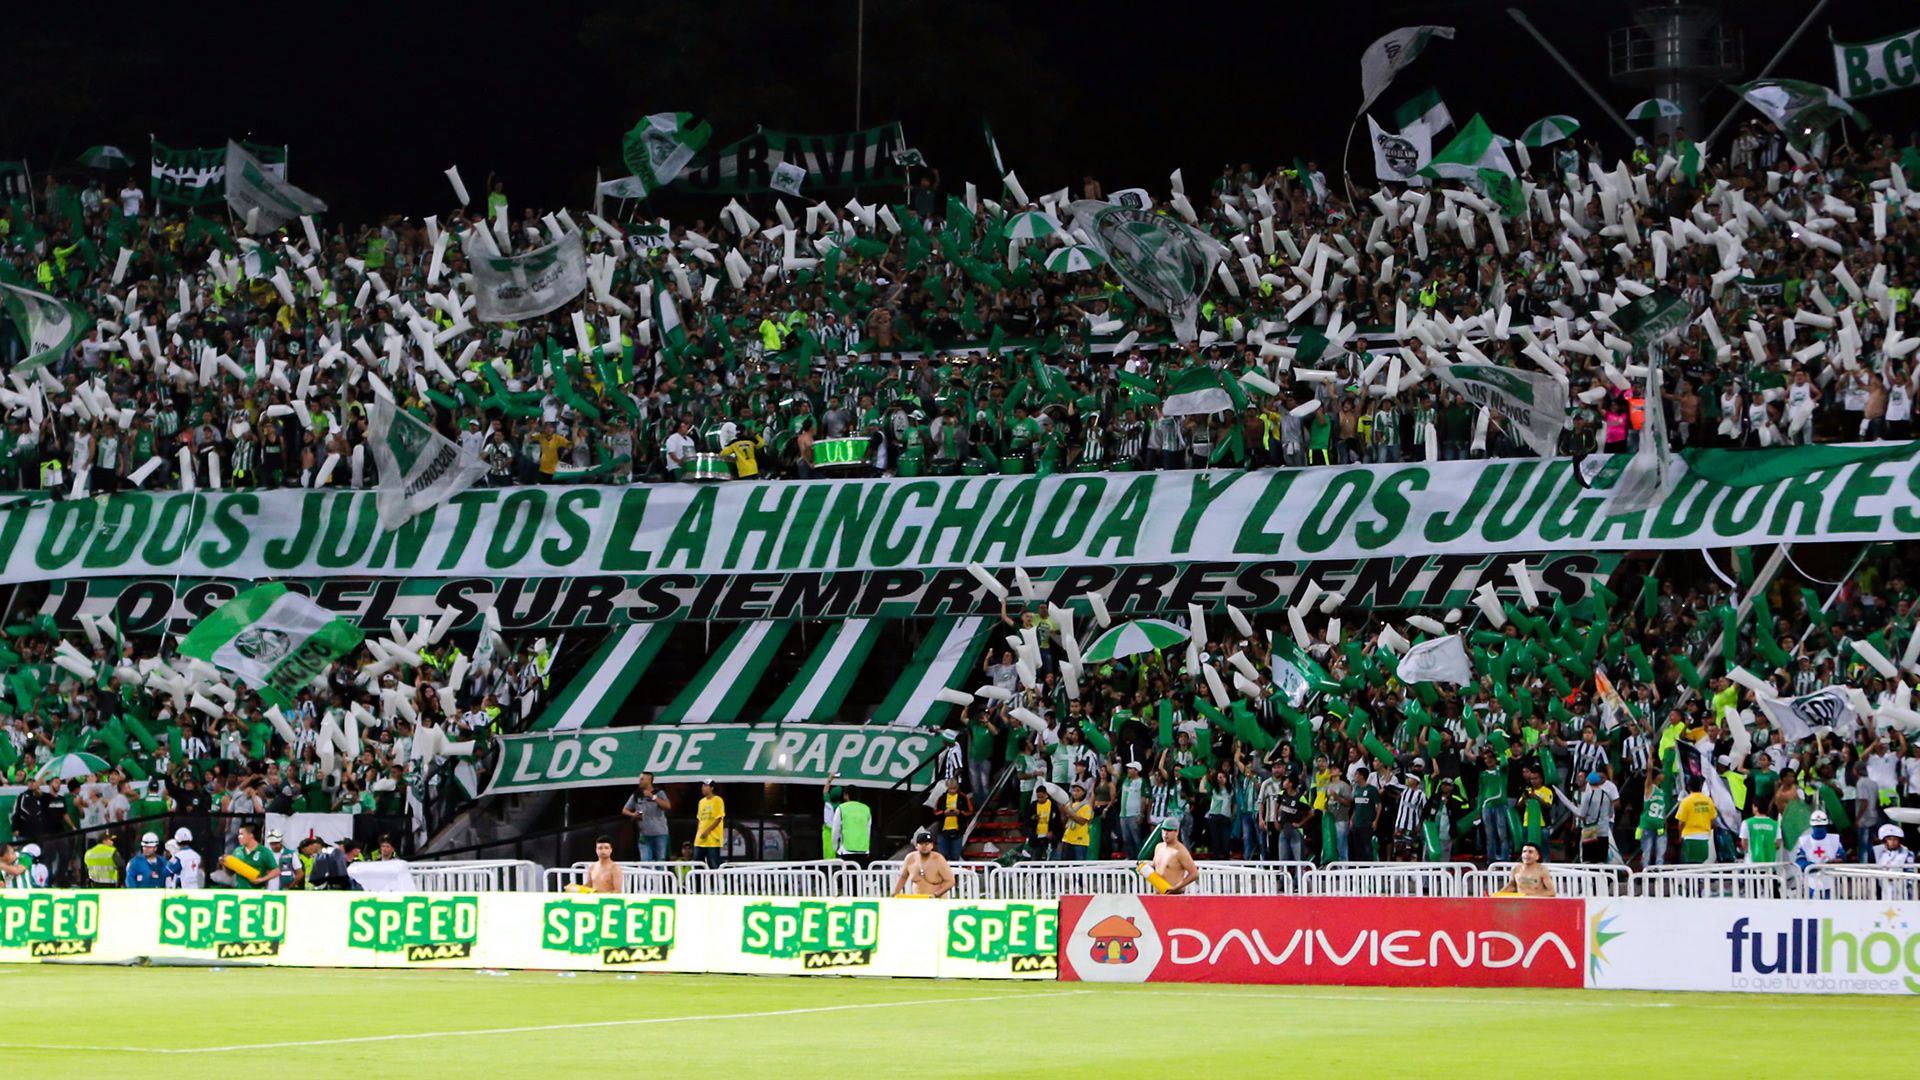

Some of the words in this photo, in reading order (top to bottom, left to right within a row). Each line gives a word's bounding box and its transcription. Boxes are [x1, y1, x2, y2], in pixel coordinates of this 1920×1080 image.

[1845, 33, 1920, 95] B.C
[1463, 382, 1488, 406] LOS
[601, 486, 719, 571] LA
[723, 474, 1158, 571] HINCHADA
[1171, 470, 1246, 554] Y
[1233, 467, 1429, 554] LOS
[52, 580, 238, 636] LOS
[255, 579, 416, 632] EL
[430, 576, 627, 628] SUR
[628, 566, 1048, 622] SIEMPRE
[1049, 554, 1599, 615] PRESENTES
[511, 739, 619, 782] LOS
[645, 732, 716, 775] DE
[744, 731, 931, 778] TRAPOS
[0, 899, 98, 940] PEED
[163, 897, 286, 943] SPEED
[352, 901, 477, 944] SPEED
[547, 904, 675, 946] SPEED
[746, 906, 878, 951] SPEED
[34, 940, 87, 956] MAX
[220, 941, 272, 957] MAX
[410, 944, 464, 960] MAX
[606, 947, 661, 962] MAX
[806, 951, 864, 967] MAX
[1168, 927, 1576, 969] DAVIVIENDA
[1731, 976, 1749, 989] Lo
[1753, 977, 1782, 992] que
[1786, 976, 1800, 989] tu
[1804, 976, 1836, 990] vida
[1839, 978, 1899, 991] merece
